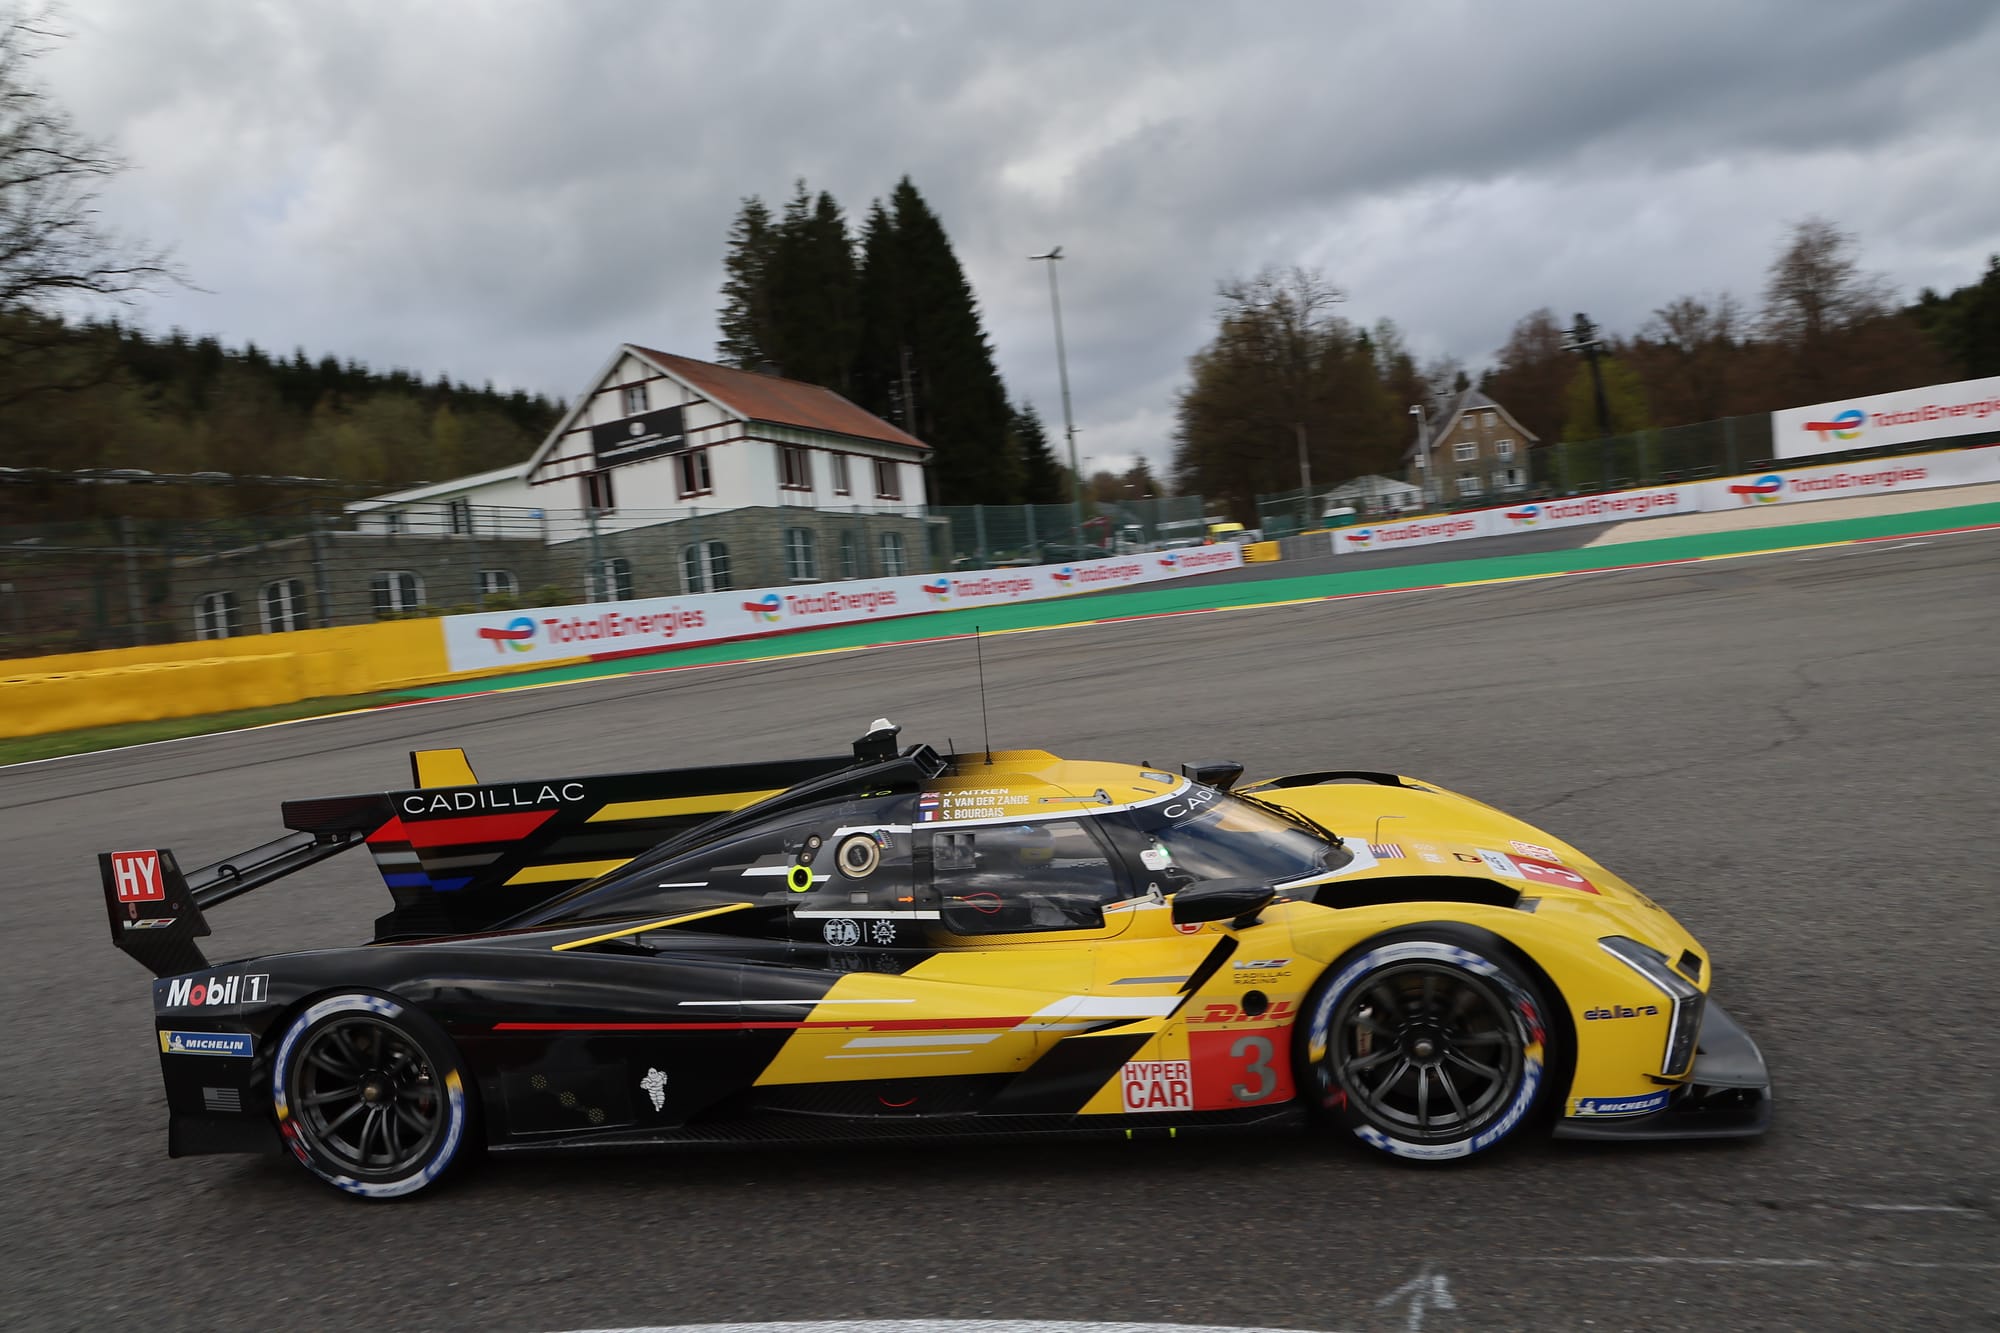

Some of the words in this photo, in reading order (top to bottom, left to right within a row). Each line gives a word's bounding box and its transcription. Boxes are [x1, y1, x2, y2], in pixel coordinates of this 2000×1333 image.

[1788, 466, 1927, 493] TotalEnergies
[1544, 490, 1679, 520] TotalEnergies
[1376, 517, 1475, 543] TotalEnergies
[952, 575, 1032, 598] TotalEnergies
[785, 587, 897, 617] TotalEnergies
[543, 605, 705, 644] TotalEnergies
[403, 783, 585, 814] CADILLAC
[943, 798, 952, 808] R.
[955, 798, 974, 807] VAN
[976, 797, 996, 806] DER
[998, 795, 1029, 806] ZANDE
[943, 810, 952, 819] S.
[954, 808, 1004, 819] BOURDAIS
[115, 856, 156, 896] HY
[826, 924, 857, 940] FIA
[166, 975, 240, 1007] Mobil
[250, 976, 260, 1001] 1
[1583, 1005, 1658, 1021] dallara
[185, 1039, 244, 1050] MICHELIN
[1125, 1063, 1188, 1081] HYPER
[1230, 1036, 1276, 1102] 3
[1125, 1080, 1190, 1109] CAR
[1597, 1096, 1665, 1113] MICHELIN
